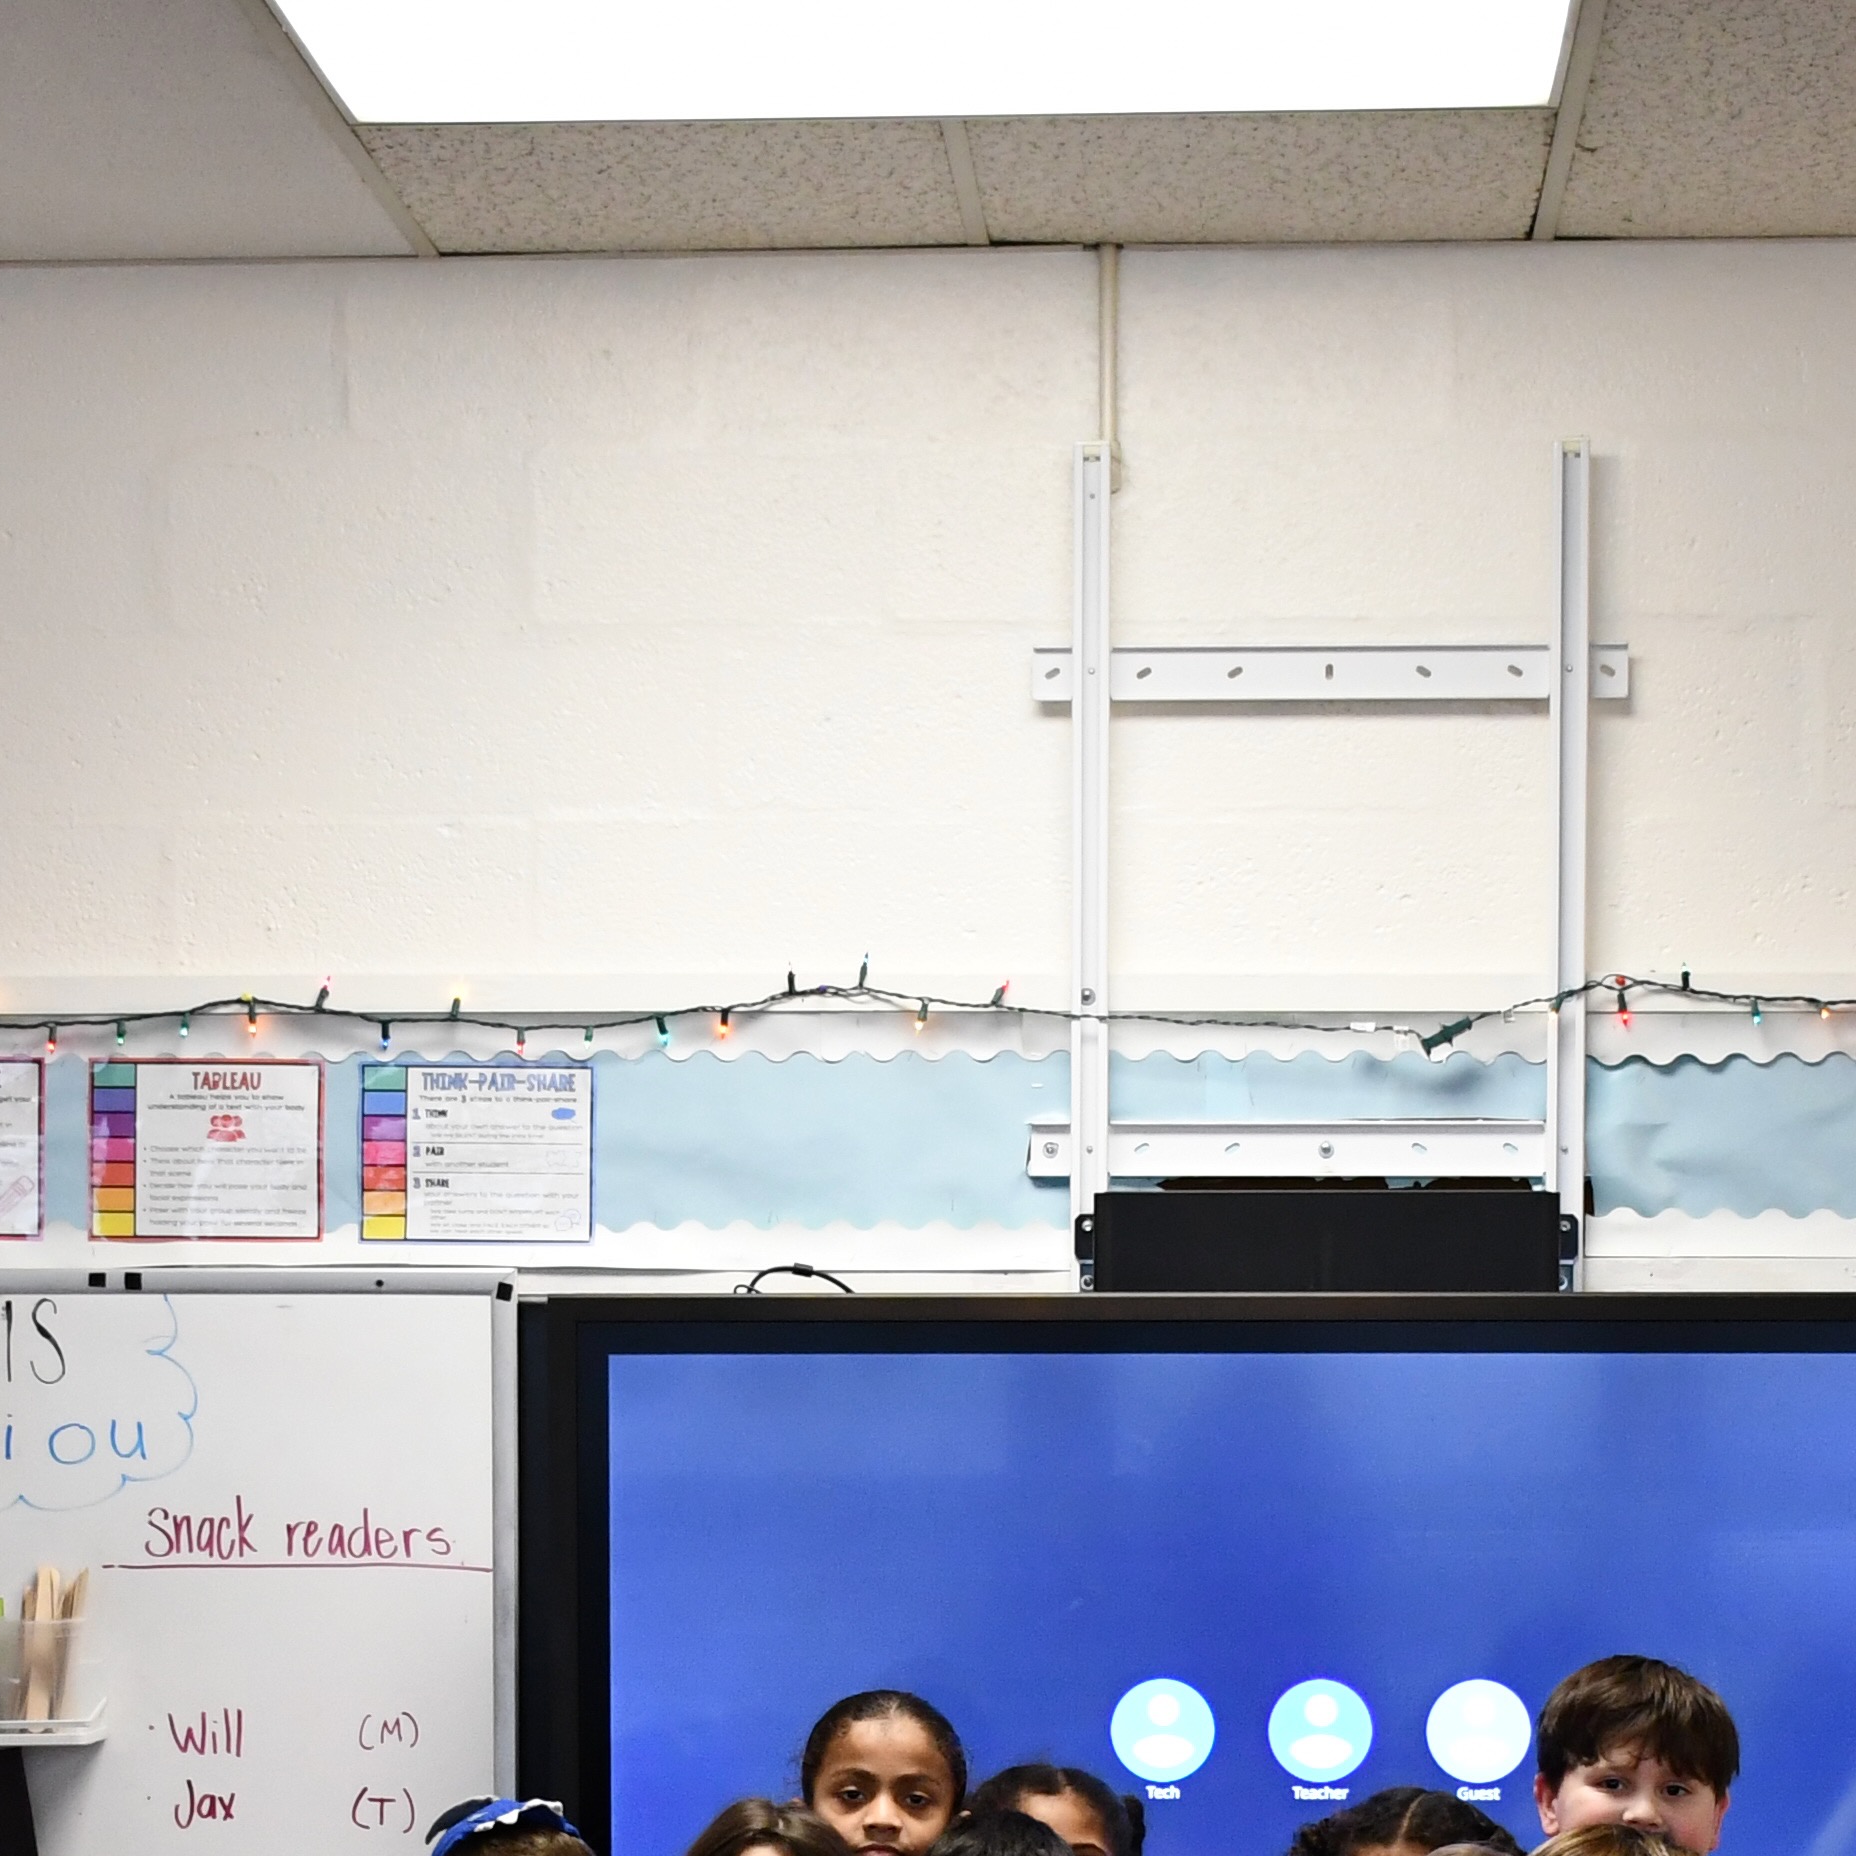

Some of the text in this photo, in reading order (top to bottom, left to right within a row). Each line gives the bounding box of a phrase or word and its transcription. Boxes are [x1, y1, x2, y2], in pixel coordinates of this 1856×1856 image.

[192, 1072, 261, 1090] TABLEAU
[425, 1147, 445, 1156] PAIR
[425, 1178, 449, 1188] SHARE
[285, 1507, 452, 1558] readers
[168, 1708, 419, 1757] Will (M)
[174, 1779, 415, 1833] Jax (T)
